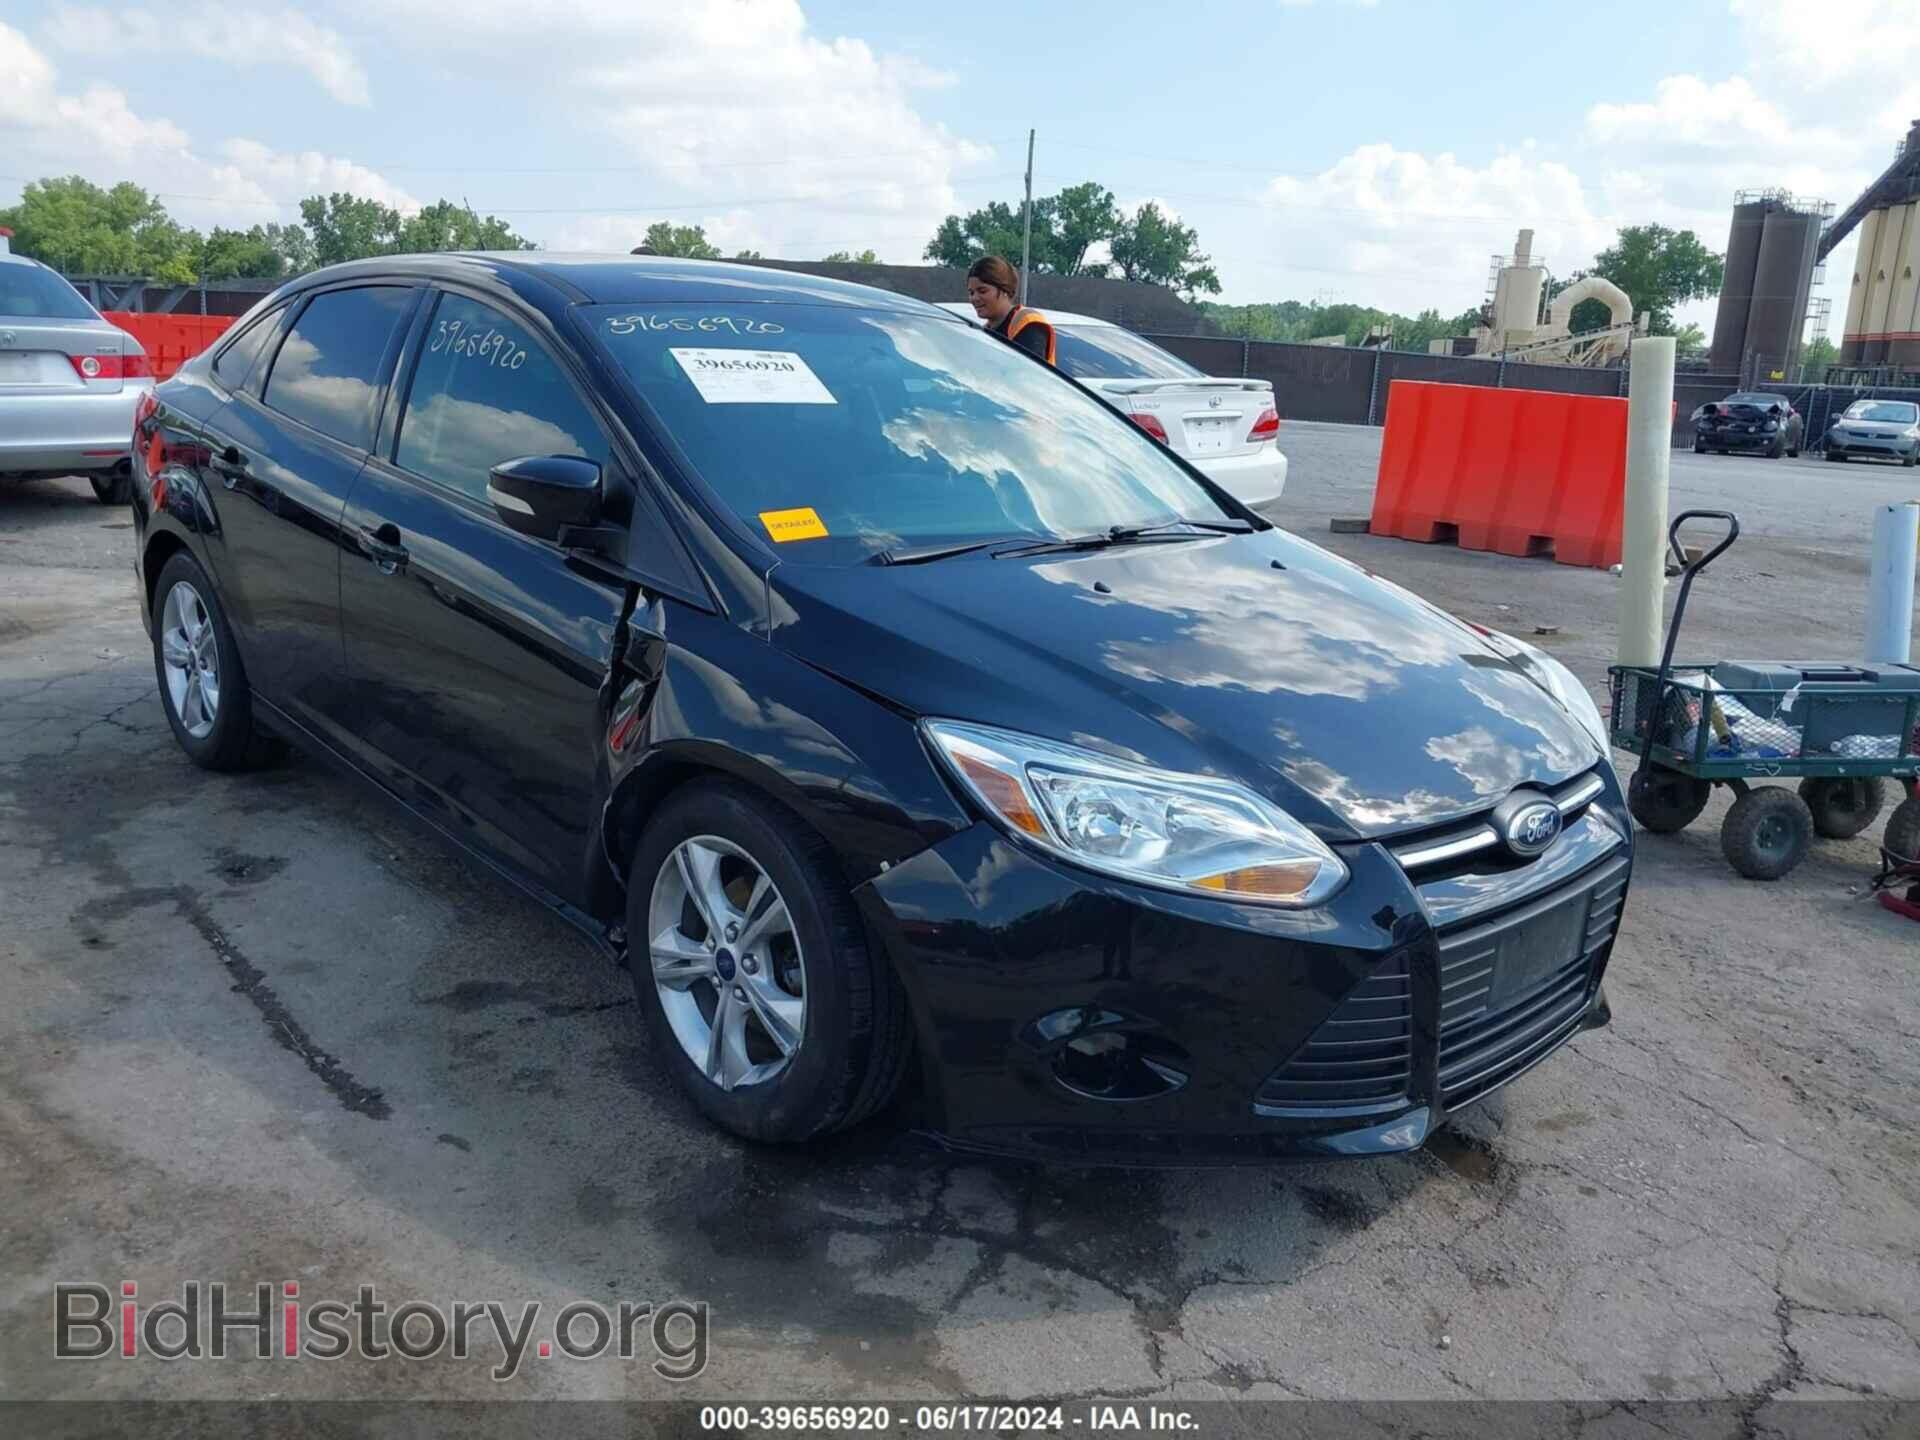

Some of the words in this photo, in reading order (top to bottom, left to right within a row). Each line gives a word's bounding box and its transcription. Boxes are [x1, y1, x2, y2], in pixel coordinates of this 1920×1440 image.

[606, 314, 785, 336] 39656920
[431, 320, 527, 370] 39656920
[693, 358, 796, 373] 39656920
[1527, 812, 1553, 842] Ford
